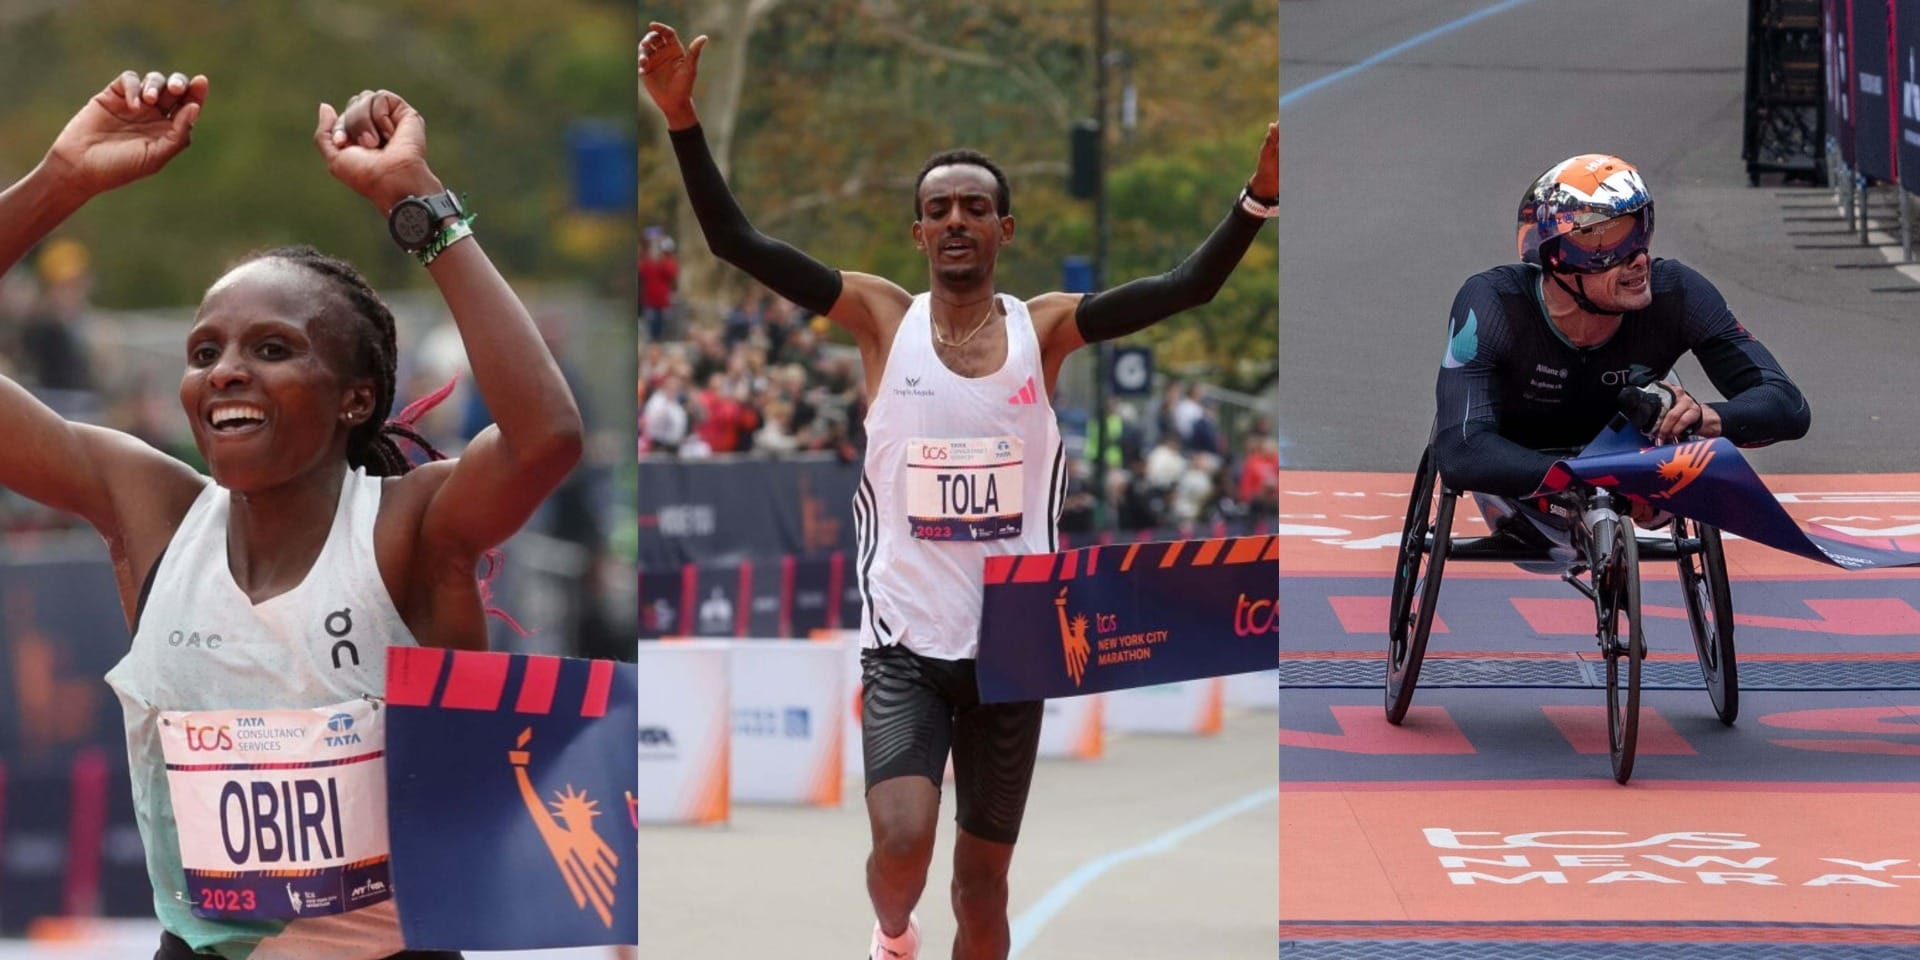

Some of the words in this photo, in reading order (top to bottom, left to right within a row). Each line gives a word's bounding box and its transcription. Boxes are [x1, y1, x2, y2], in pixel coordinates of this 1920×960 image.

[937, 473, 999, 515] TOLA
[917, 526, 952, 538] 2023
[1096, 612, 1117, 633] tcs
[168, 630, 222, 649] OAC
[1098, 638, 1117, 651] NEW
[1119, 633, 1145, 647] YORK
[1146, 630, 1168, 644] CITY
[1098, 647, 1151, 665] MARATHON
[236, 717, 265, 728] TATA
[185, 720, 233, 751] tcs
[236, 728, 306, 740] CONSULTANCY
[324, 734, 361, 747] TATA
[237, 741, 281, 751] SERVICES
[219, 777, 345, 865] OBIRI
[1421, 827, 1762, 850] tcs
[1437, 854, 1779, 870] NEW
[201, 887, 257, 912] 2023
